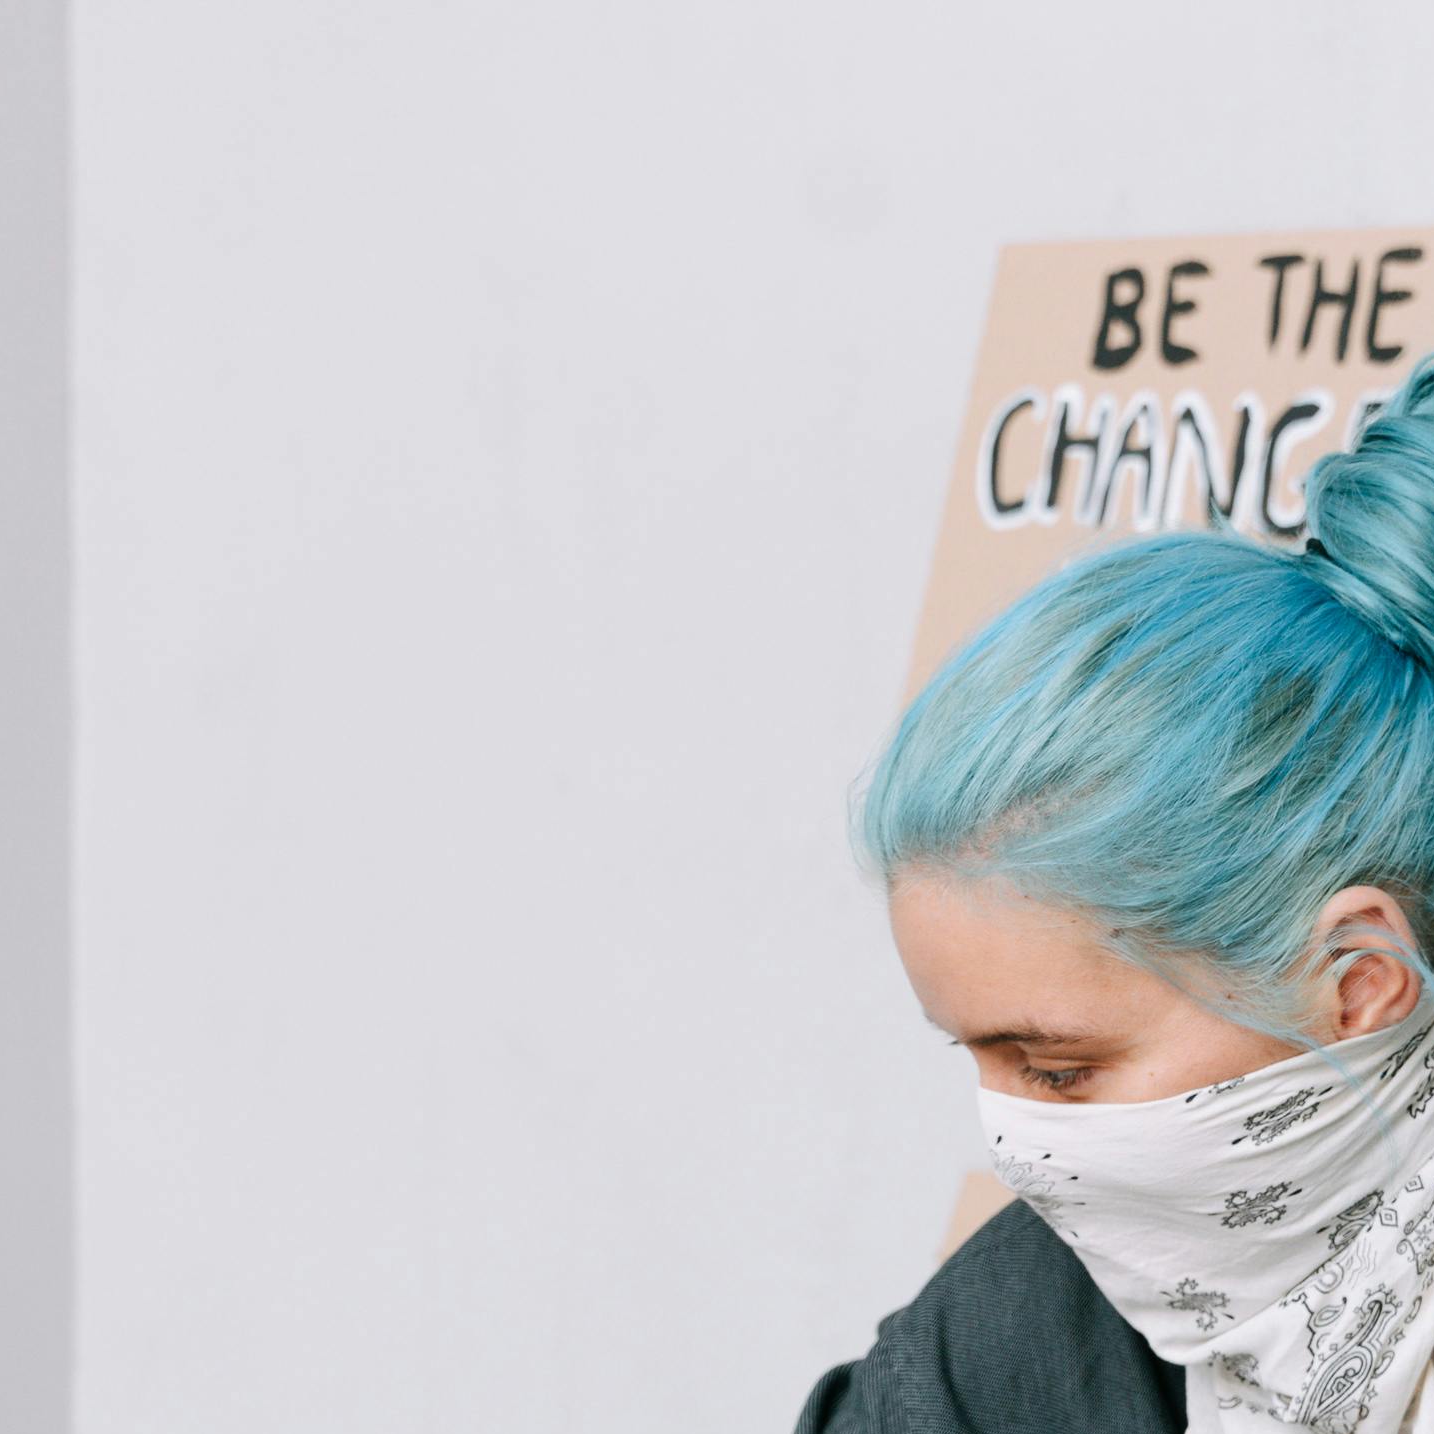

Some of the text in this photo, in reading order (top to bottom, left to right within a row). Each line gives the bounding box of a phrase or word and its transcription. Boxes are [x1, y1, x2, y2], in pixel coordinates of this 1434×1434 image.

[1091, 247, 1424, 371] BE THE
[979, 385, 1393, 544] CHANG
